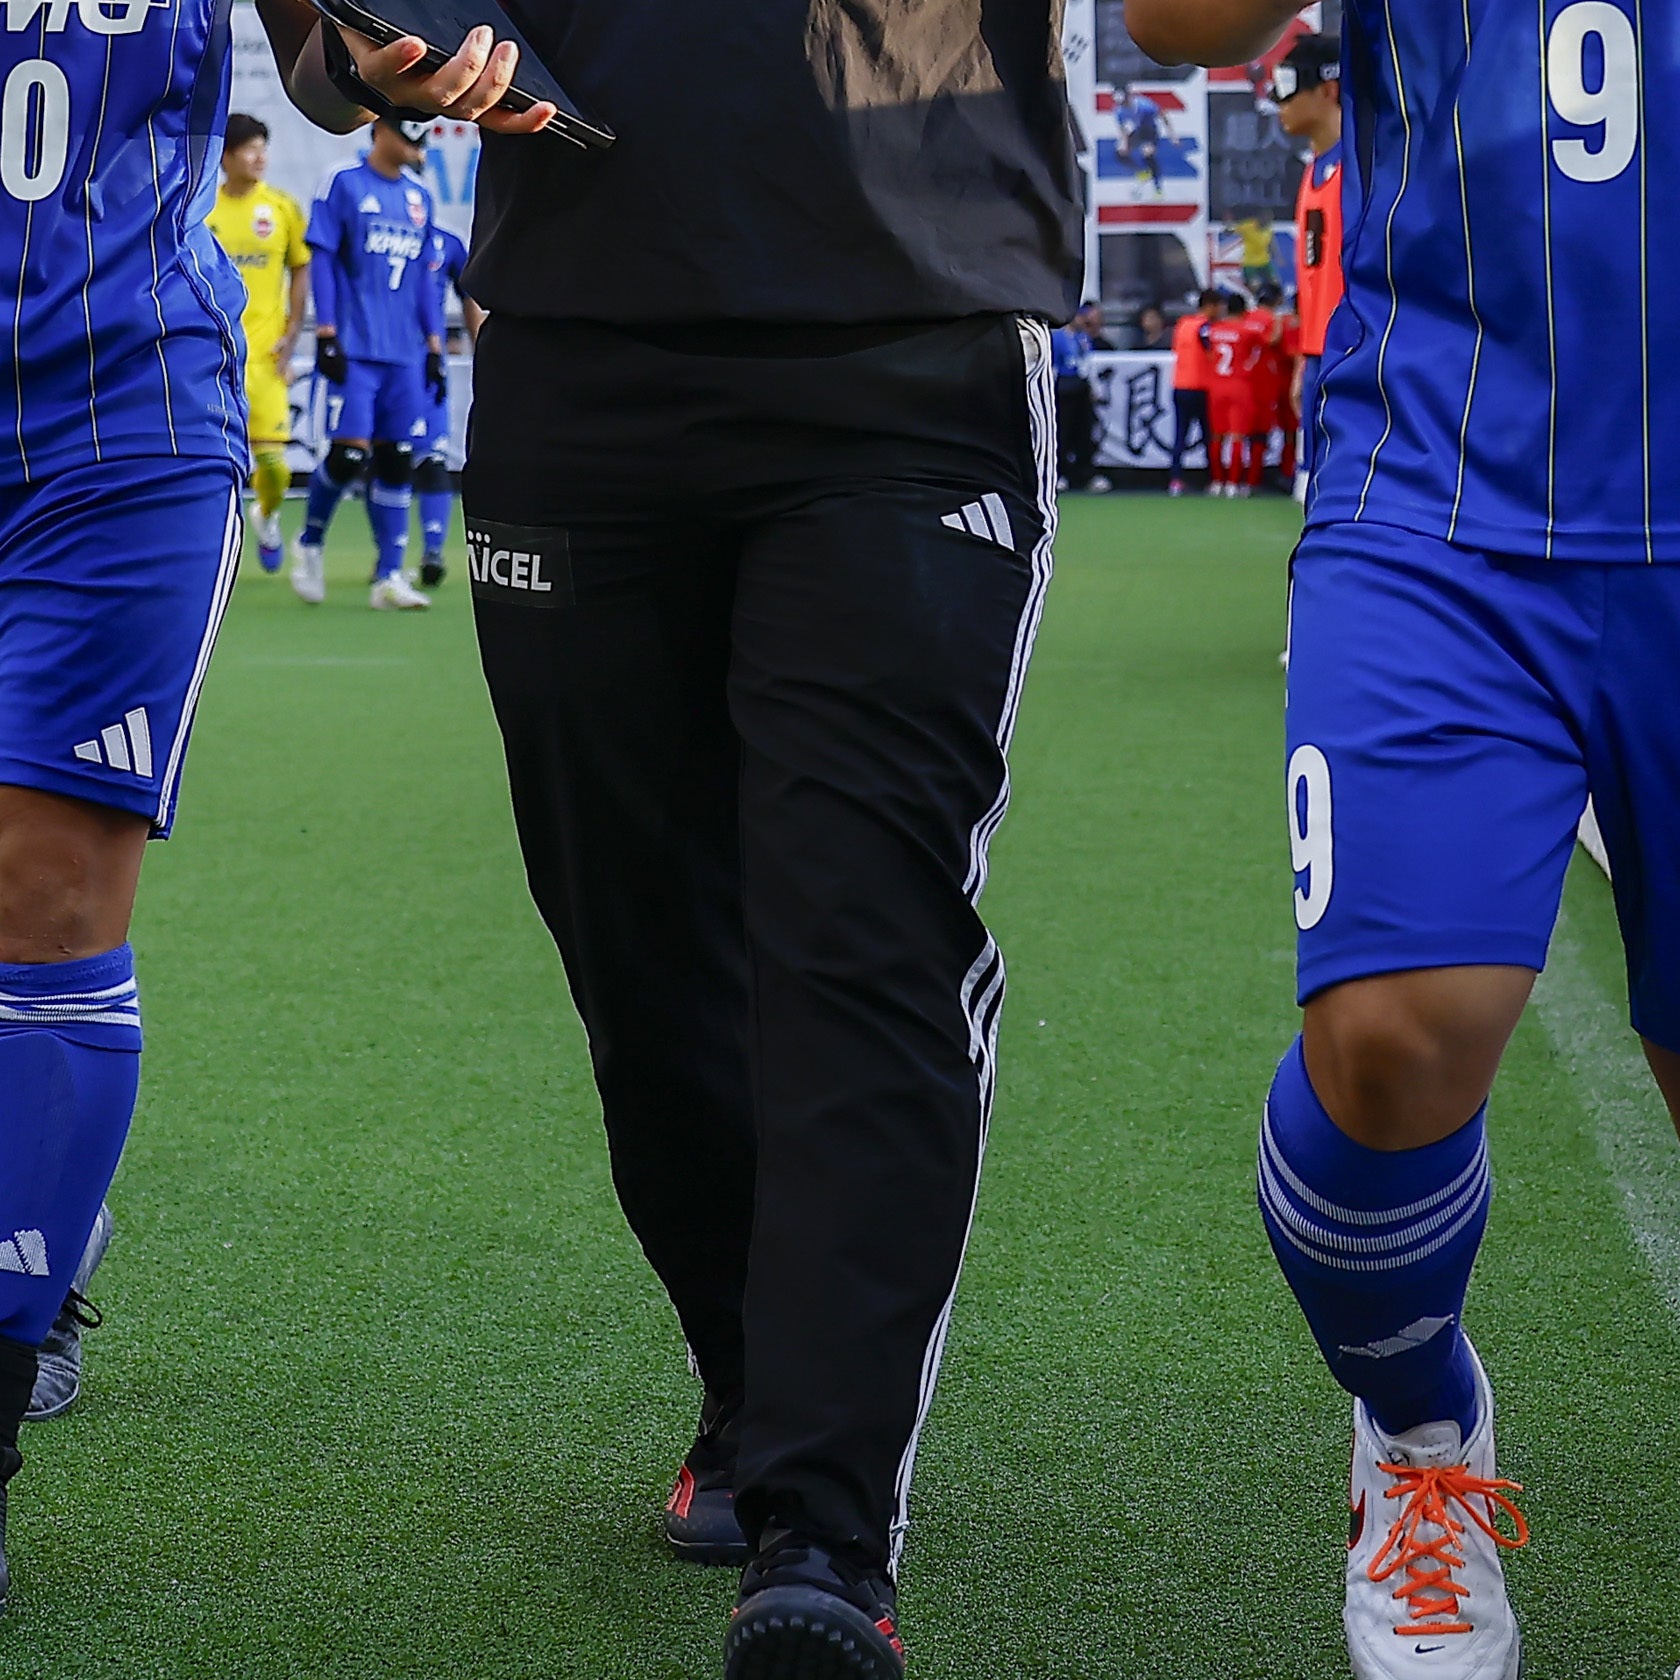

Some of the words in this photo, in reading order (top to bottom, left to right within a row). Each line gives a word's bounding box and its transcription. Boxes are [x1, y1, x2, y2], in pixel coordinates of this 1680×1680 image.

[1548, 1, 1640, 183] 9
[387, 256, 408, 291] 7
[1216, 343, 1234, 376] 2
[467, 538, 552, 592] AICEL
[1287, 745, 1335, 931] 9
